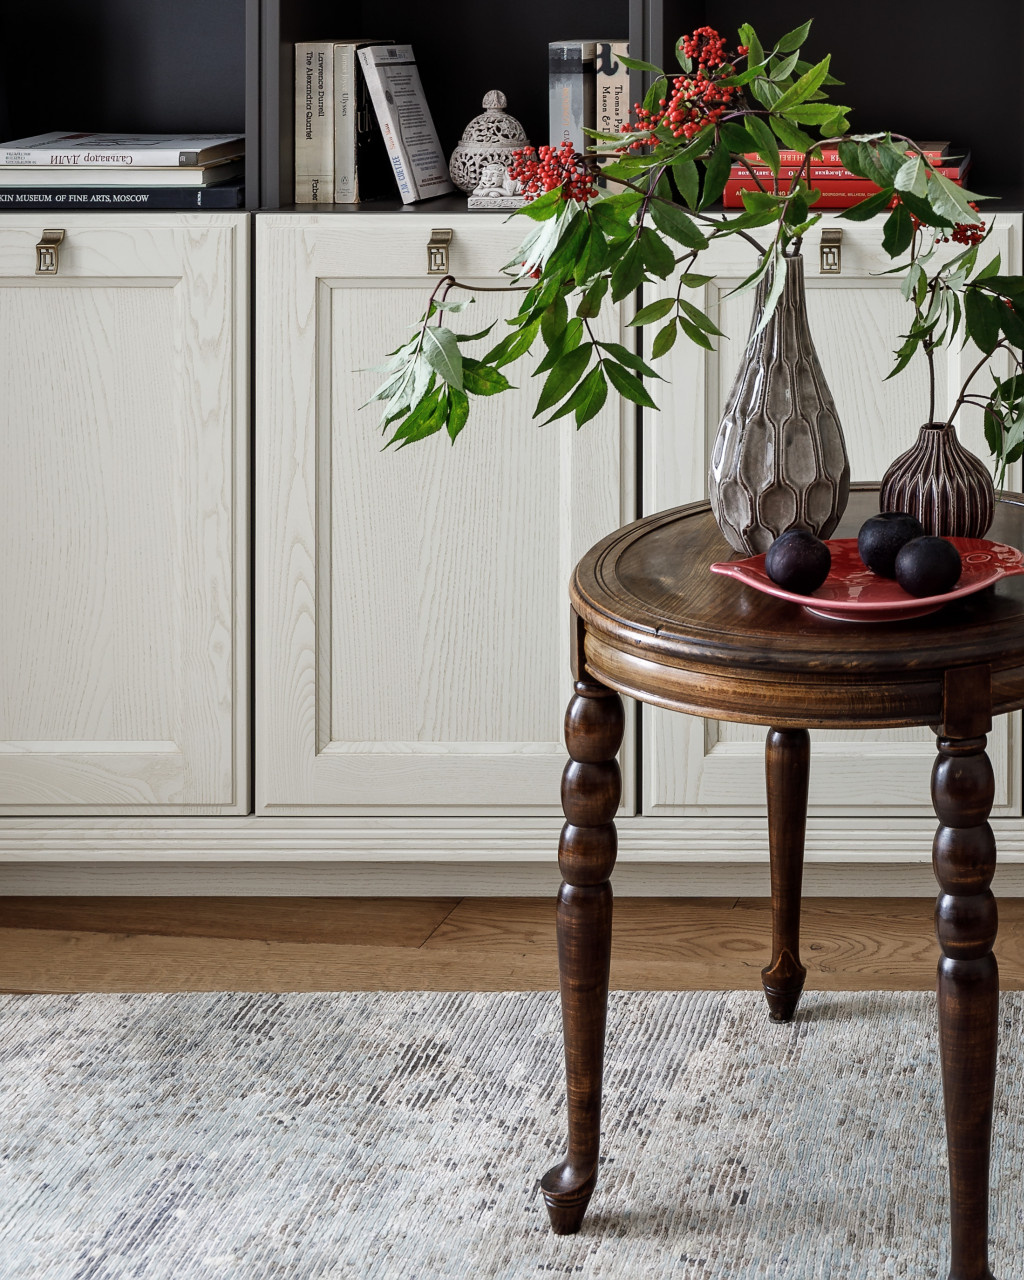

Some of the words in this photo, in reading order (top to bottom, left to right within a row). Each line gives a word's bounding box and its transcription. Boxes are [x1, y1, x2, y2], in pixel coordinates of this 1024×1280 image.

[602, 86, 610, 112] Mason
[614, 85, 623, 116] Thomas
[602, 116, 612, 126] &
[50, 154, 80, 164] ДАЛИ
[84, 153, 133, 165] Сальвадор
[90, 194, 112, 202] ARTS,
